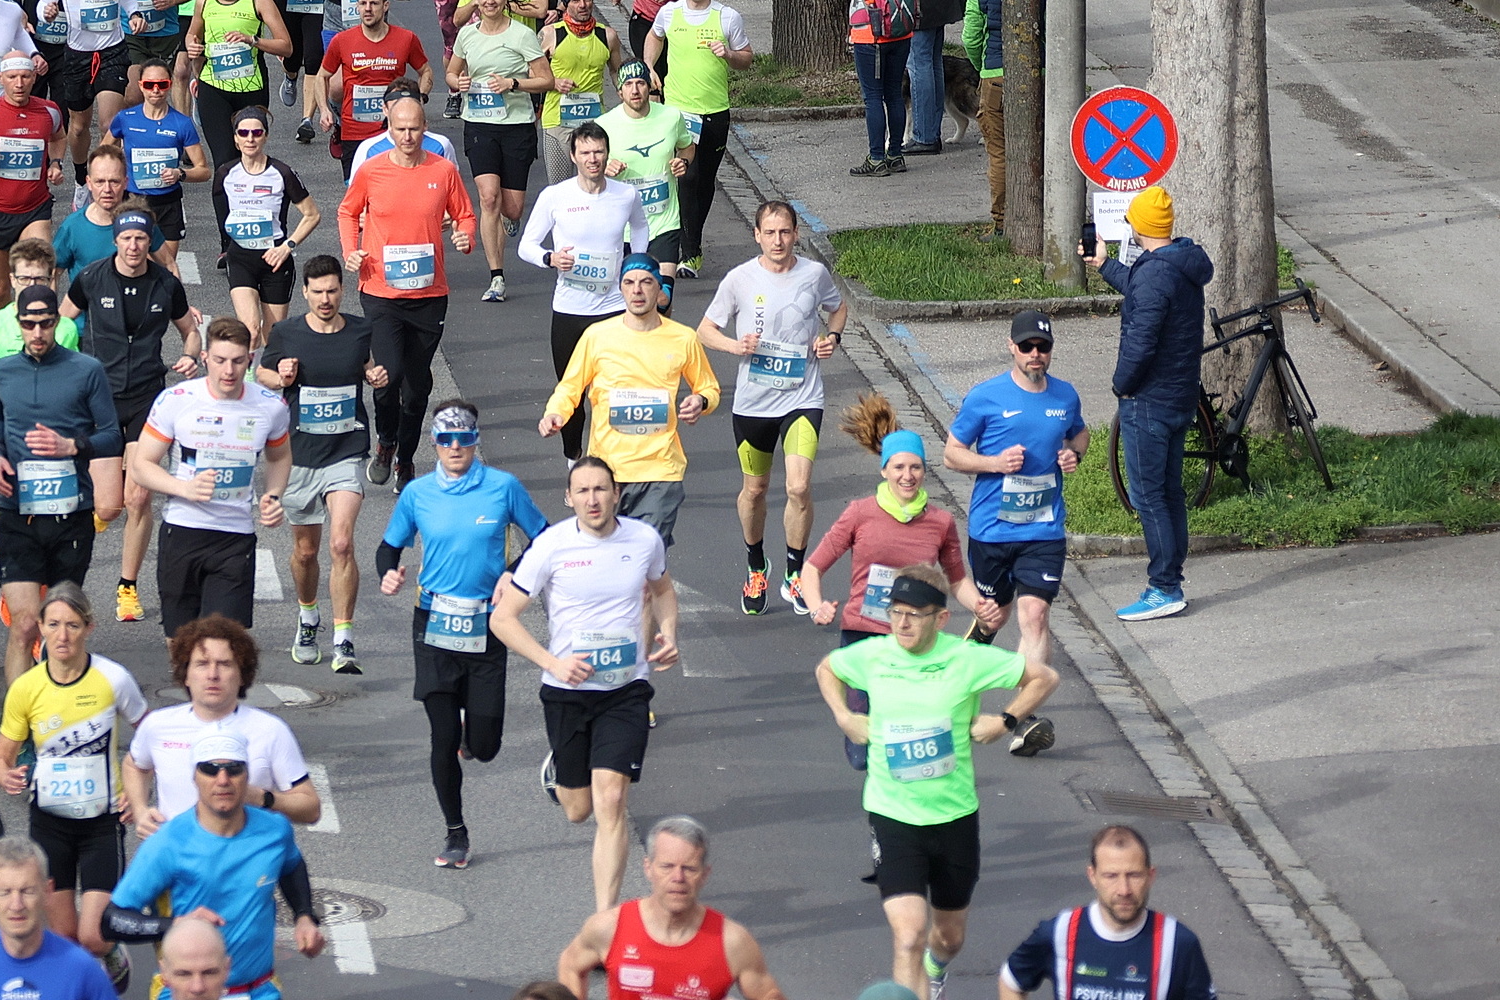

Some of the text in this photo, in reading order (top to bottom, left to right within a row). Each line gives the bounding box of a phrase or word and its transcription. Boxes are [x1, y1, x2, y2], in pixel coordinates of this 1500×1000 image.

[93, 8, 108, 19] 74
[46, 22, 67, 33] 259
[220, 56, 242, 66] 426
[353, 56, 399, 68] happy fitness
[363, 99, 384, 110] 153
[473, 94, 495, 106] 152
[570, 106, 592, 116] 427
[8, 153, 33, 165] 273
[1106, 177, 1147, 191] ANFANG
[236, 224, 260, 236] 219
[400, 261, 418, 274] 30
[573, 264, 607, 279] 2083
[764, 357, 791, 373] 301
[313, 404, 343, 419] 354
[624, 407, 653, 422] 192
[33, 480, 62, 495] 227
[1016, 492, 1043, 507] 341
[564, 560, 592, 568] ROTAX
[442, 616, 473, 633] 199
[590, 649, 622, 666] 164
[902, 740, 938, 760] 186
[50, 779, 96, 797] 2219
